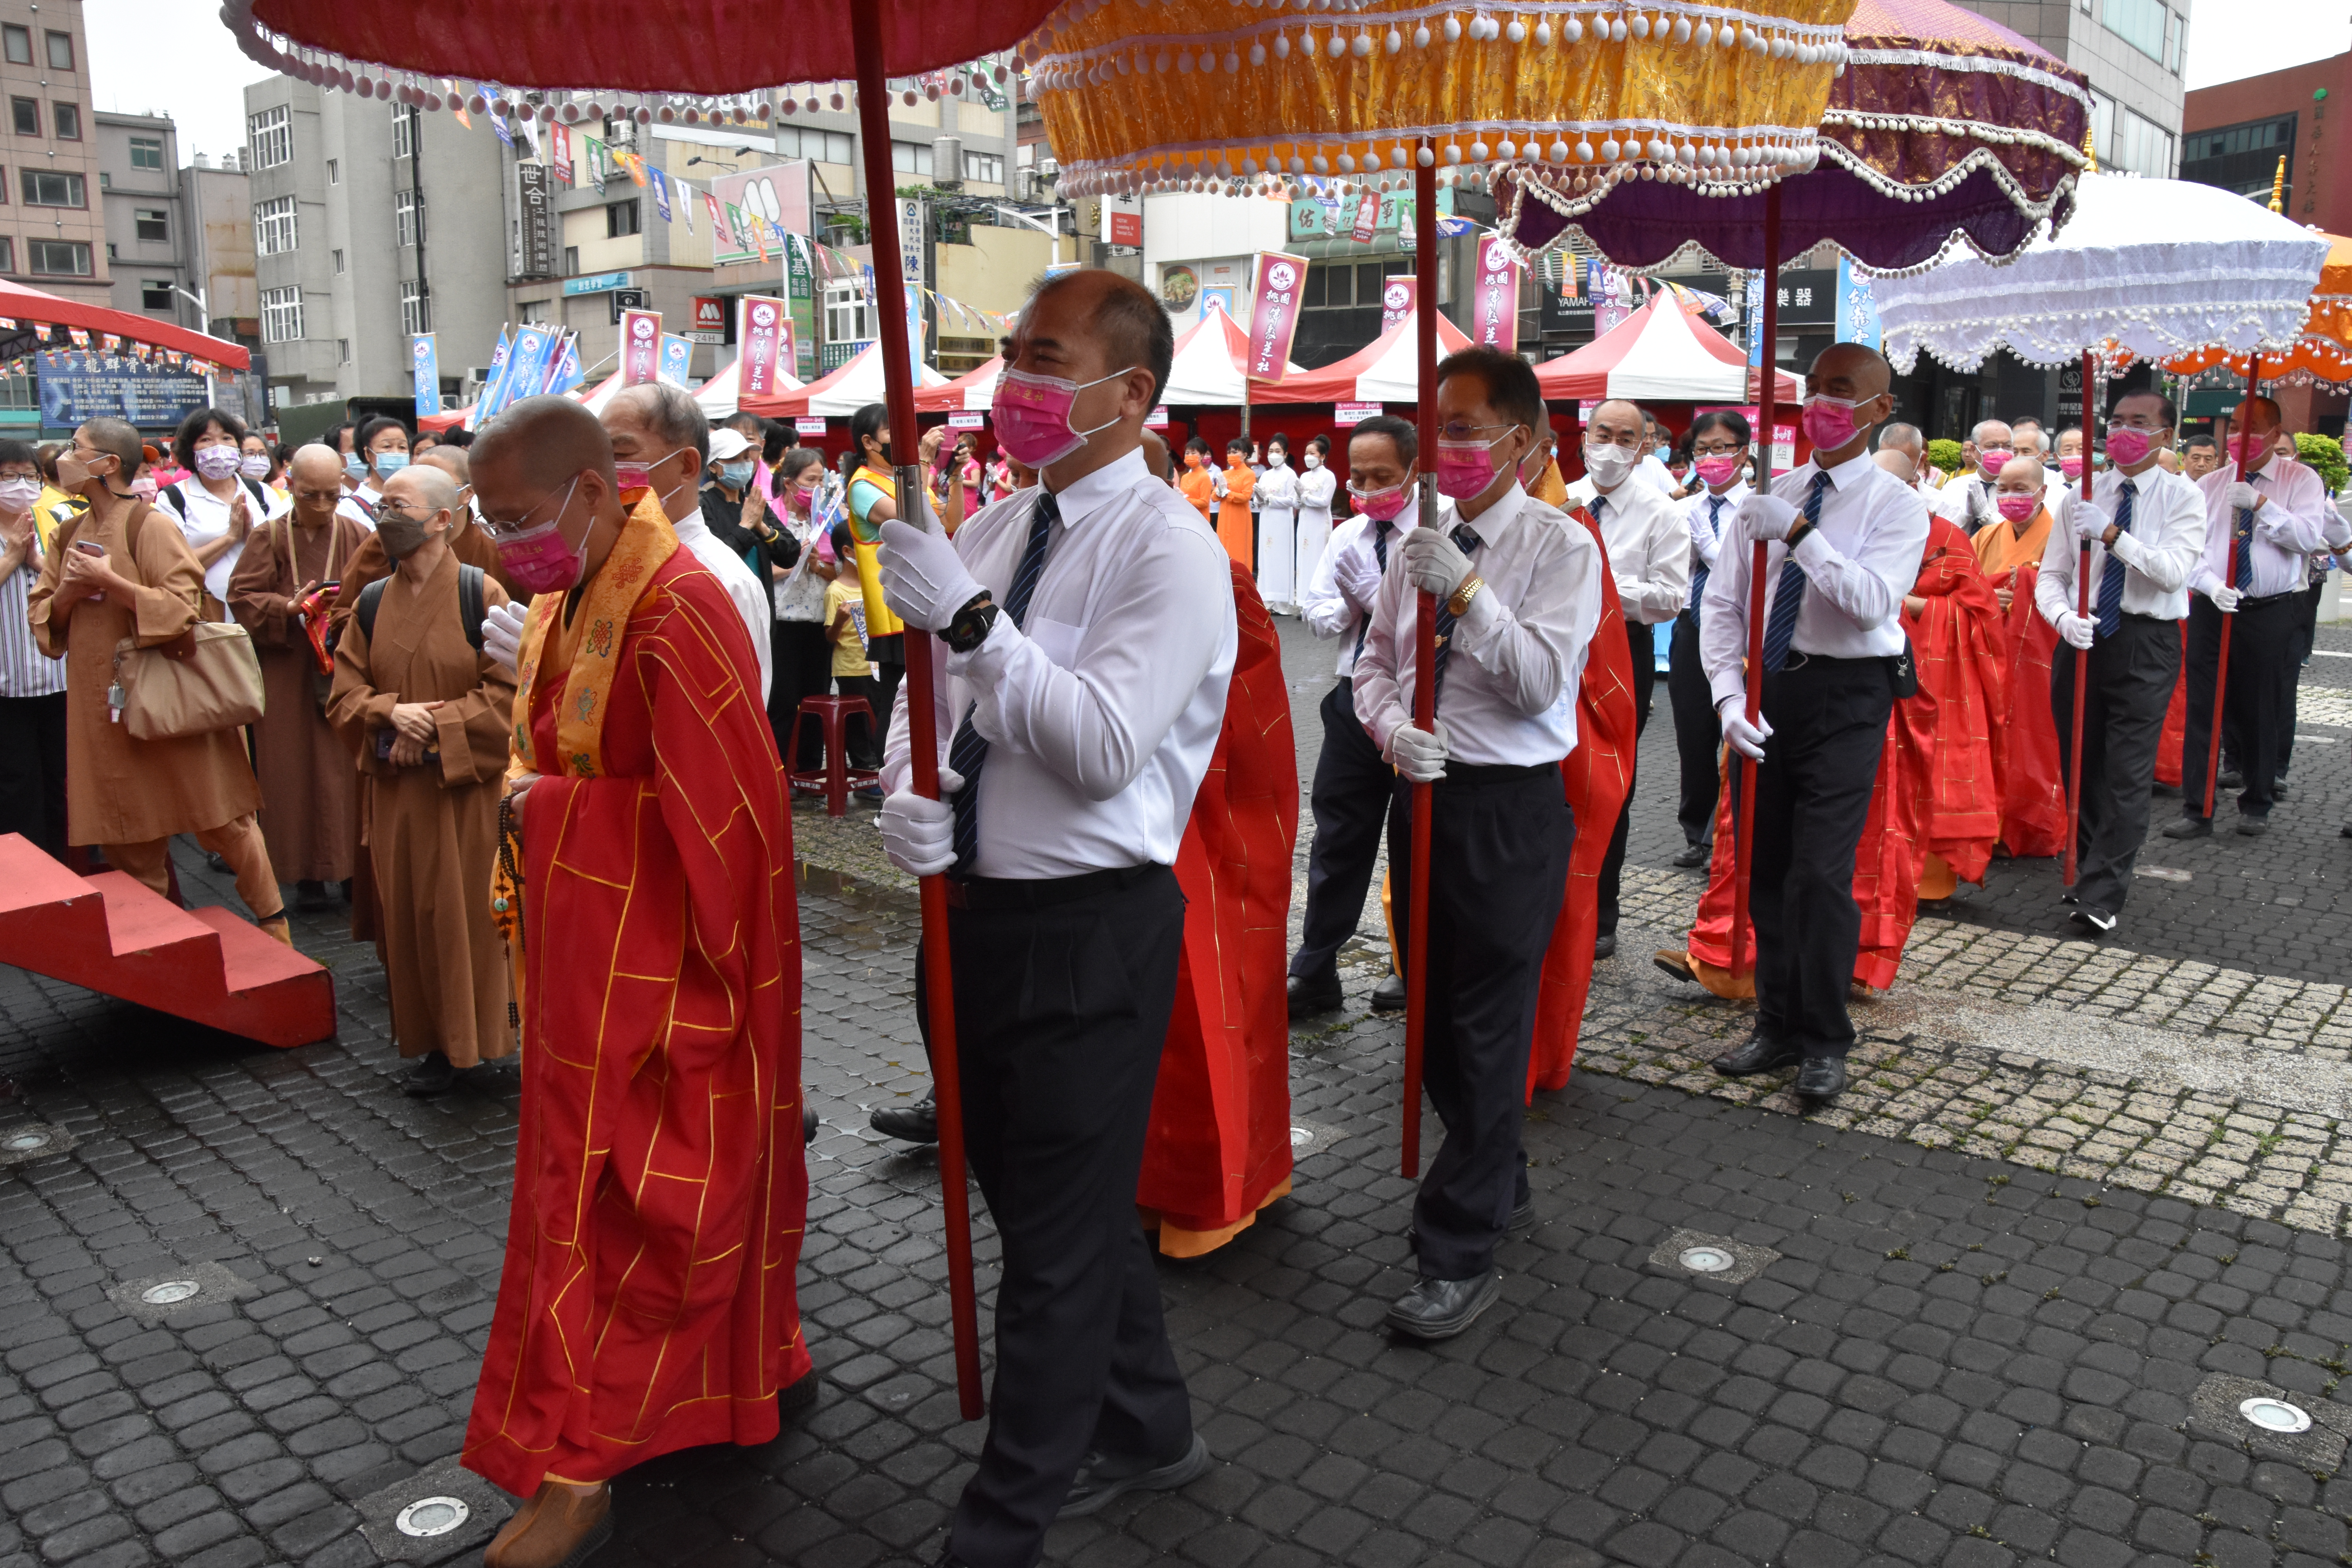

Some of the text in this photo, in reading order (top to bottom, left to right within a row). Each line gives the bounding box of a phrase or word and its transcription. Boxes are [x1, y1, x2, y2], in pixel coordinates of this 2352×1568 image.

[521, 166, 545, 204] 世合
[1485, 271, 1508, 286] 桃園
[1266, 289, 1290, 305] 桃園
[1777, 288, 1812, 307] 樂器
[1848, 287, 1873, 305] 台北
[752, 326, 773, 338] 桃園
[633, 338, 653, 350] 桃園
[83, 357, 192, 374] 龍群骨科
